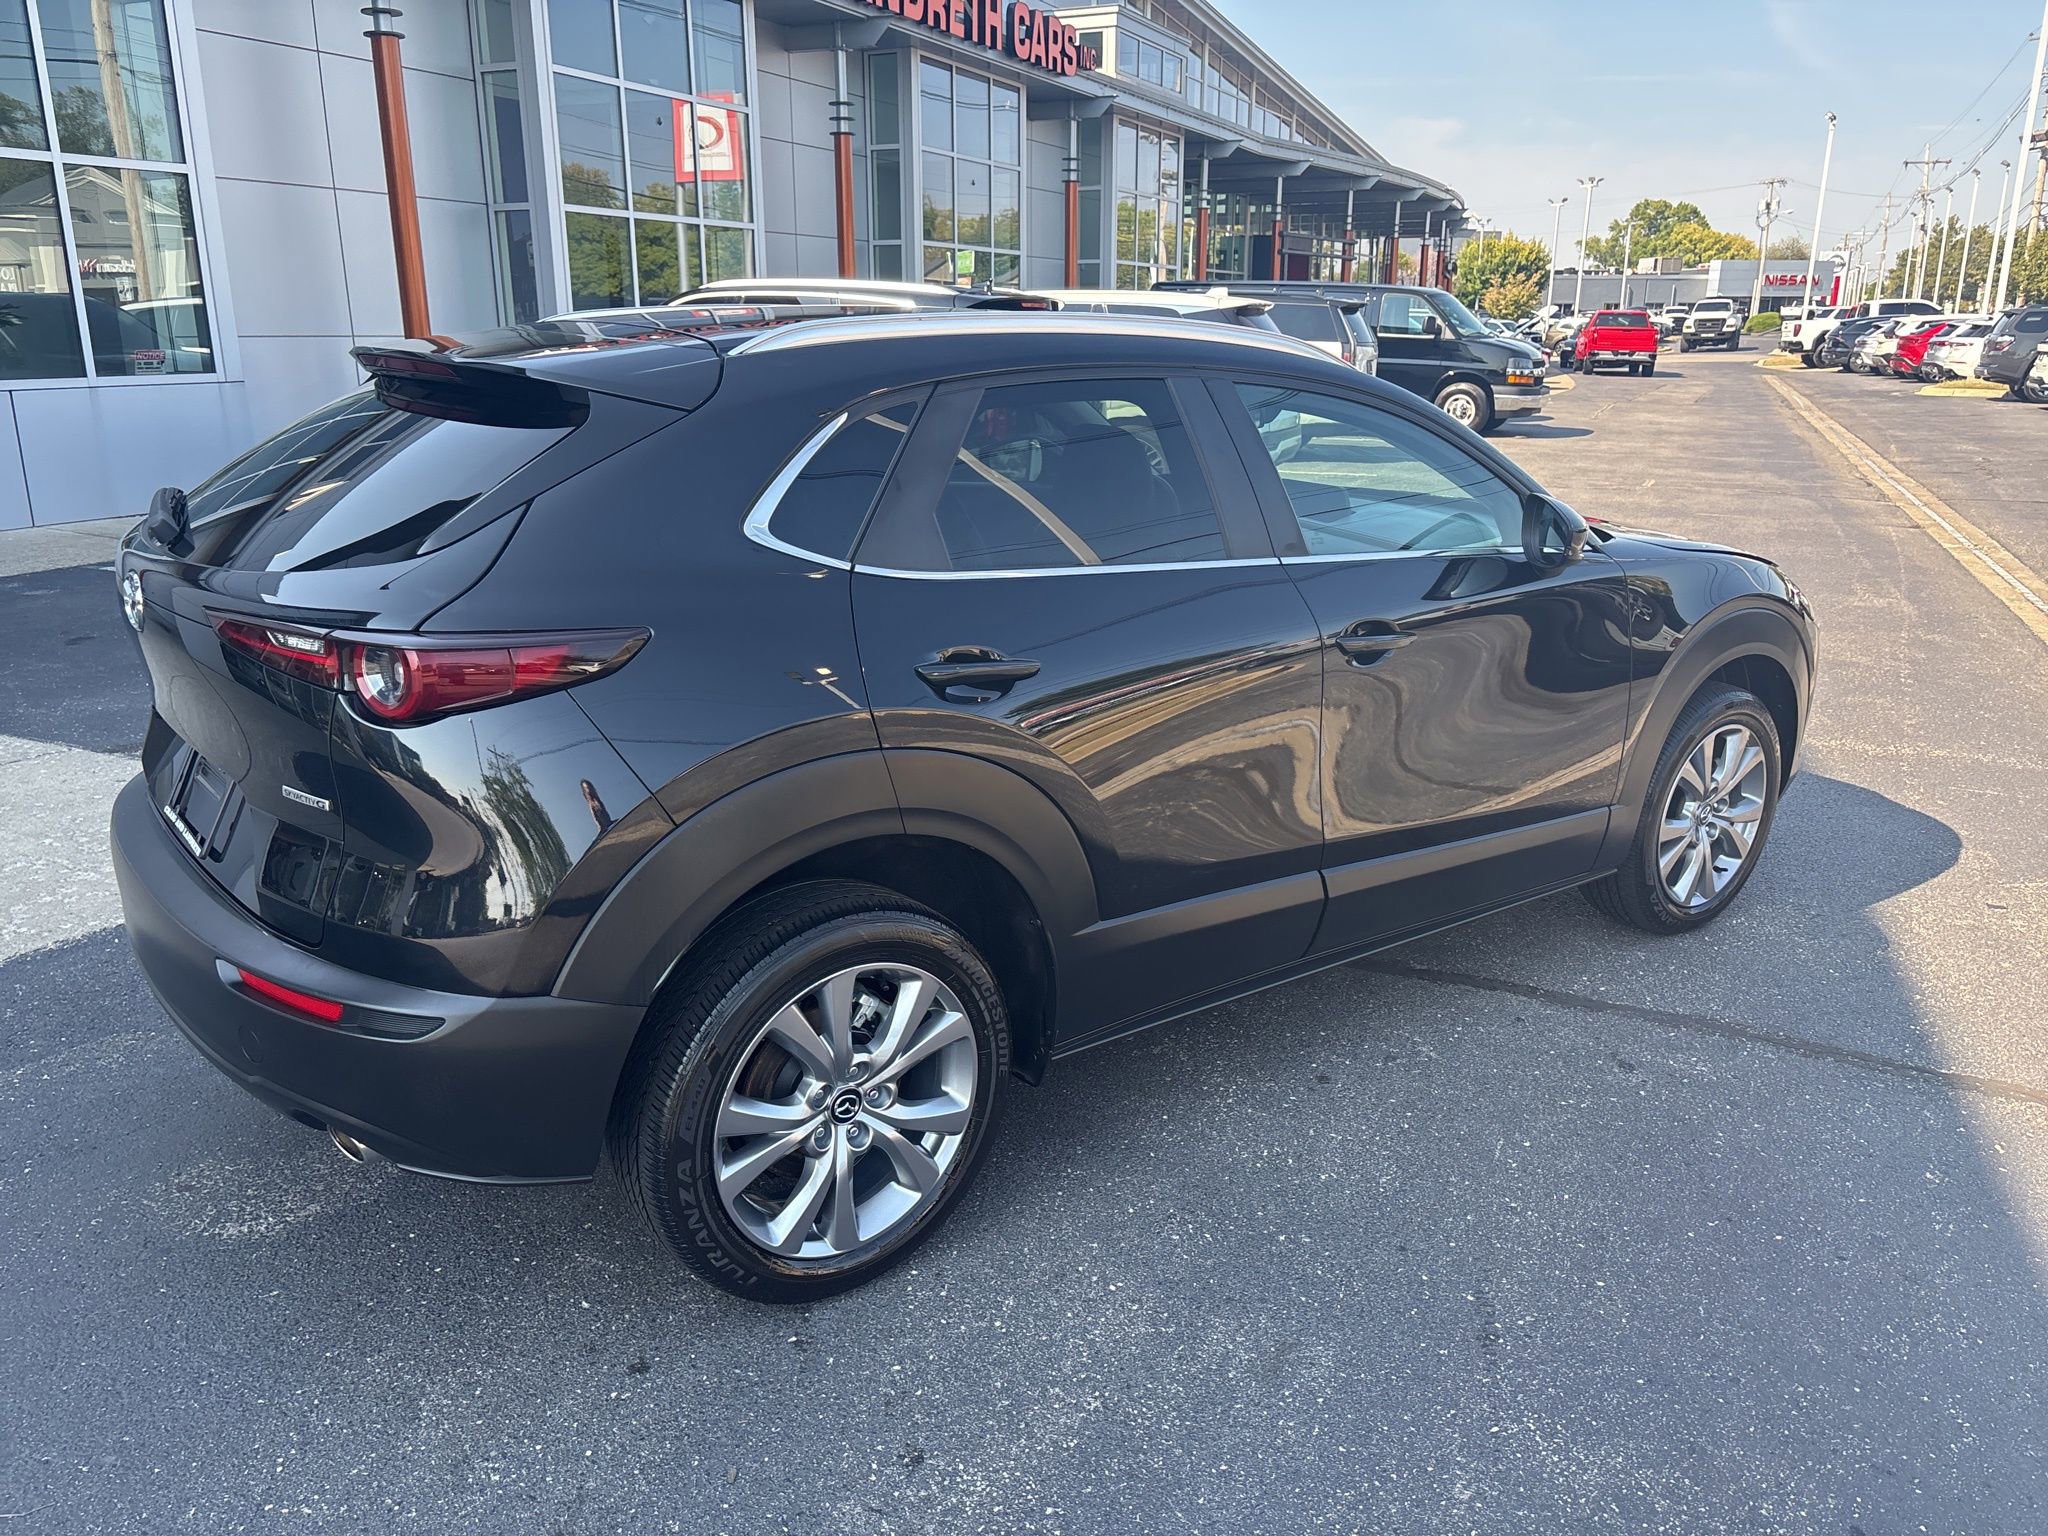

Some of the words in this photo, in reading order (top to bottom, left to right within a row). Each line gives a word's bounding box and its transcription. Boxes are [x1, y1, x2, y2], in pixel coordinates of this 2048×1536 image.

[1010, 2, 1078, 76] CARS
[1079, 44, 1097, 71] INC
[1764, 273, 1821, 287] NISSAN
[136, 351, 165, 360] NOTICE
[677, 1159, 758, 1285] TURANZA
